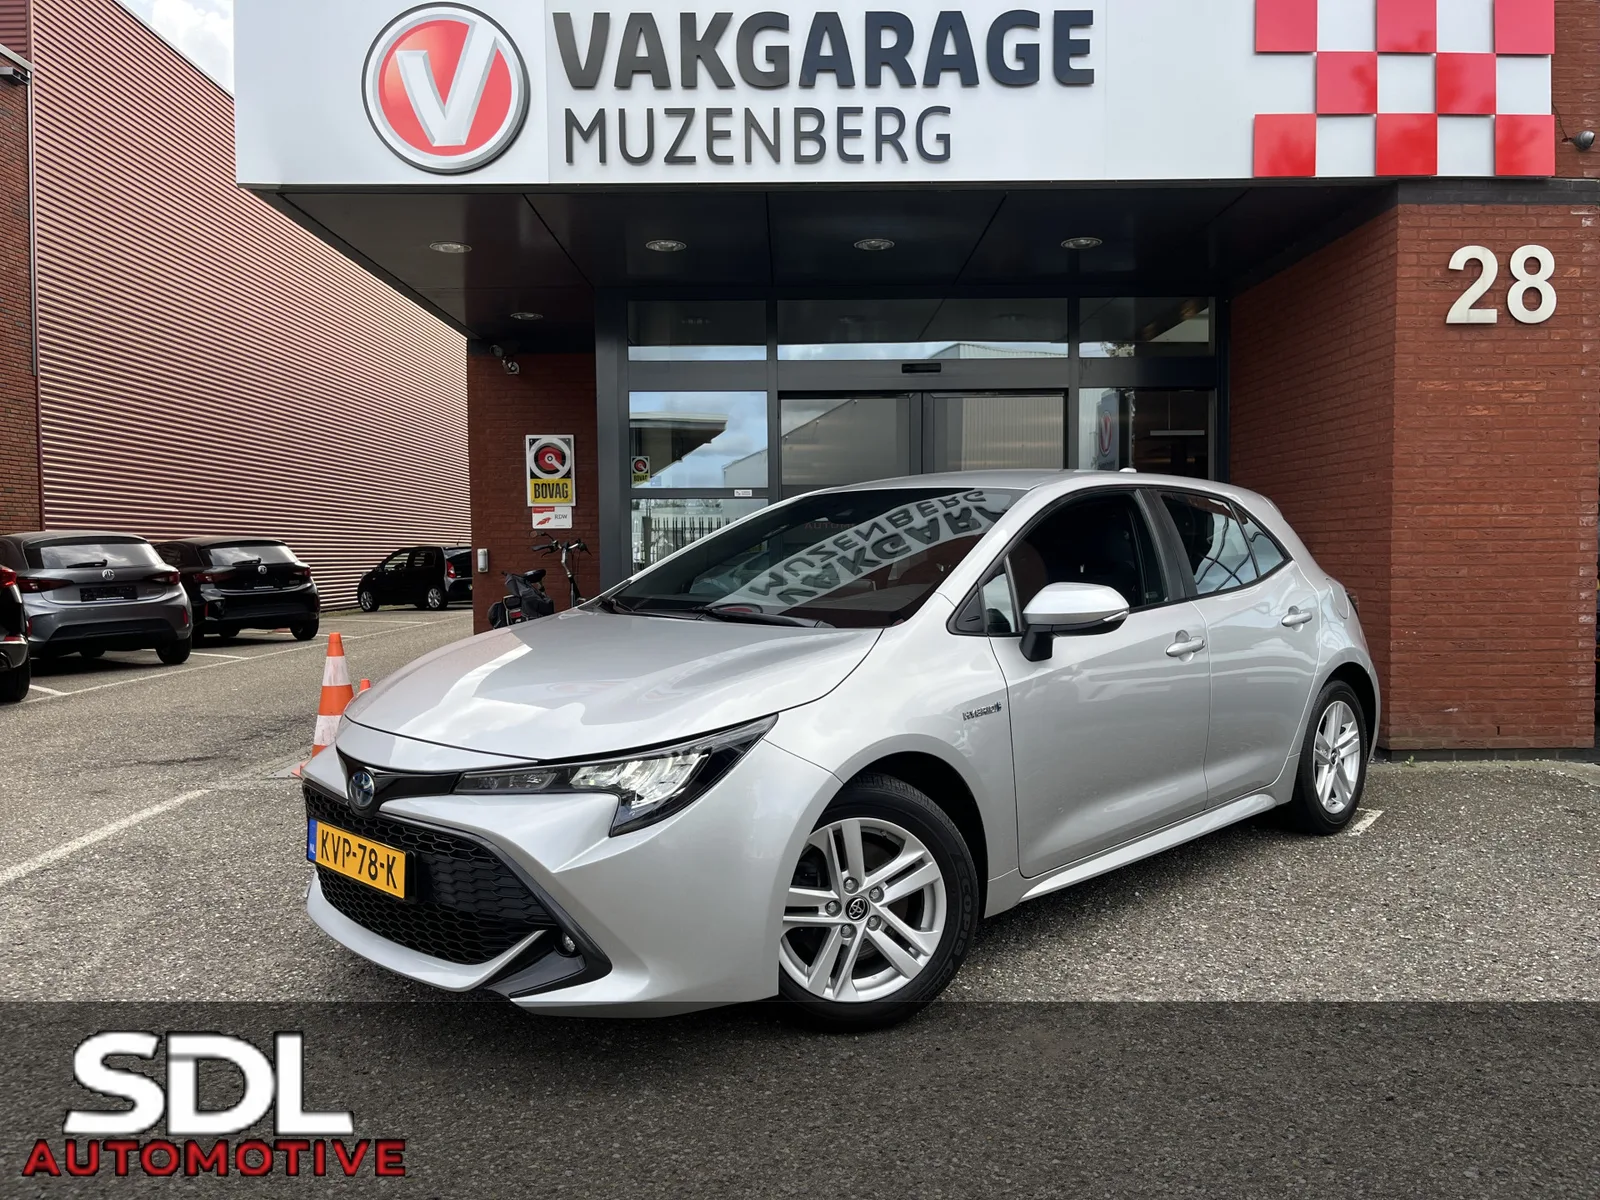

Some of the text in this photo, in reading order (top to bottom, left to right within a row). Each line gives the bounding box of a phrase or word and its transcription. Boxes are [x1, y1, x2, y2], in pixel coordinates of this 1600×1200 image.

[394, 21, 502, 147] V
[552, 9, 1095, 89] VAKGARAGE
[565, 106, 951, 165] MUZENBERG
[1445, 244, 1557, 324] 28
[534, 482, 569, 499] BOVAG
[320, 828, 398, 889] KVP-78-K
